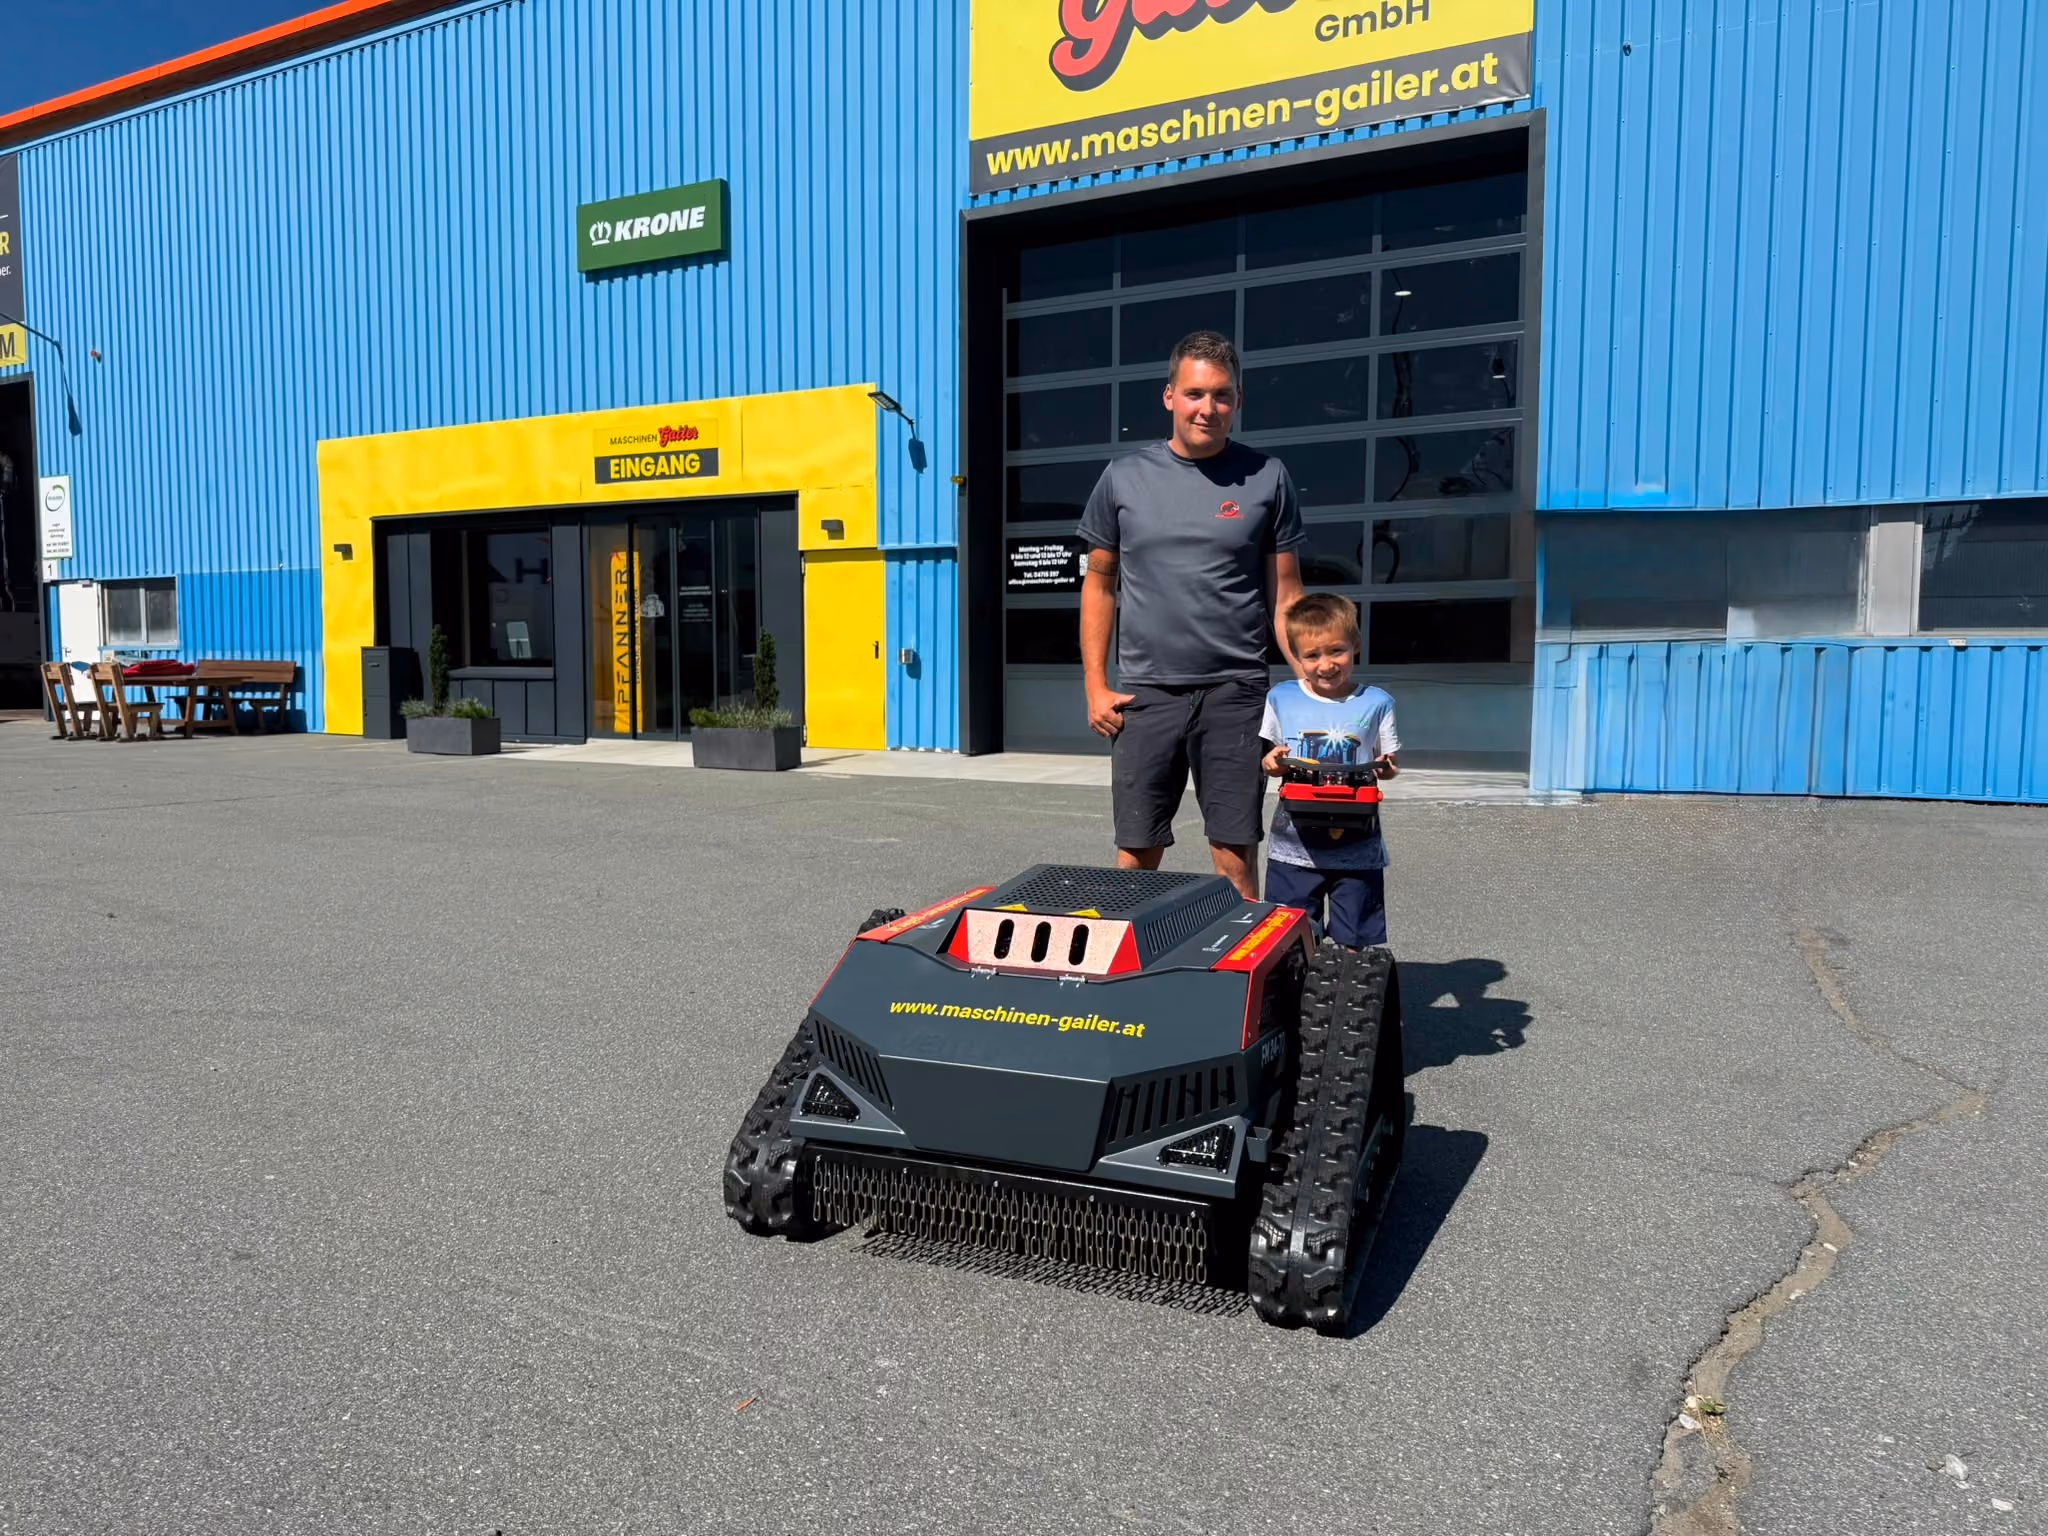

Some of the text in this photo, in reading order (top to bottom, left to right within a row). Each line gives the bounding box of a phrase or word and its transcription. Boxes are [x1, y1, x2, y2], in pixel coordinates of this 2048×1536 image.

[1315, 0, 1430, 43] GmbH
[986, 51, 1498, 175] www.maschinen-gailer.at
[614, 206, 706, 242] KRONE
[658, 425, 699, 448] Gailer
[610, 453, 701, 479] EINGANG
[616, 569, 630, 704] PFANNER
[889, 1001, 1145, 1038] www.maschinen-gailer.at
